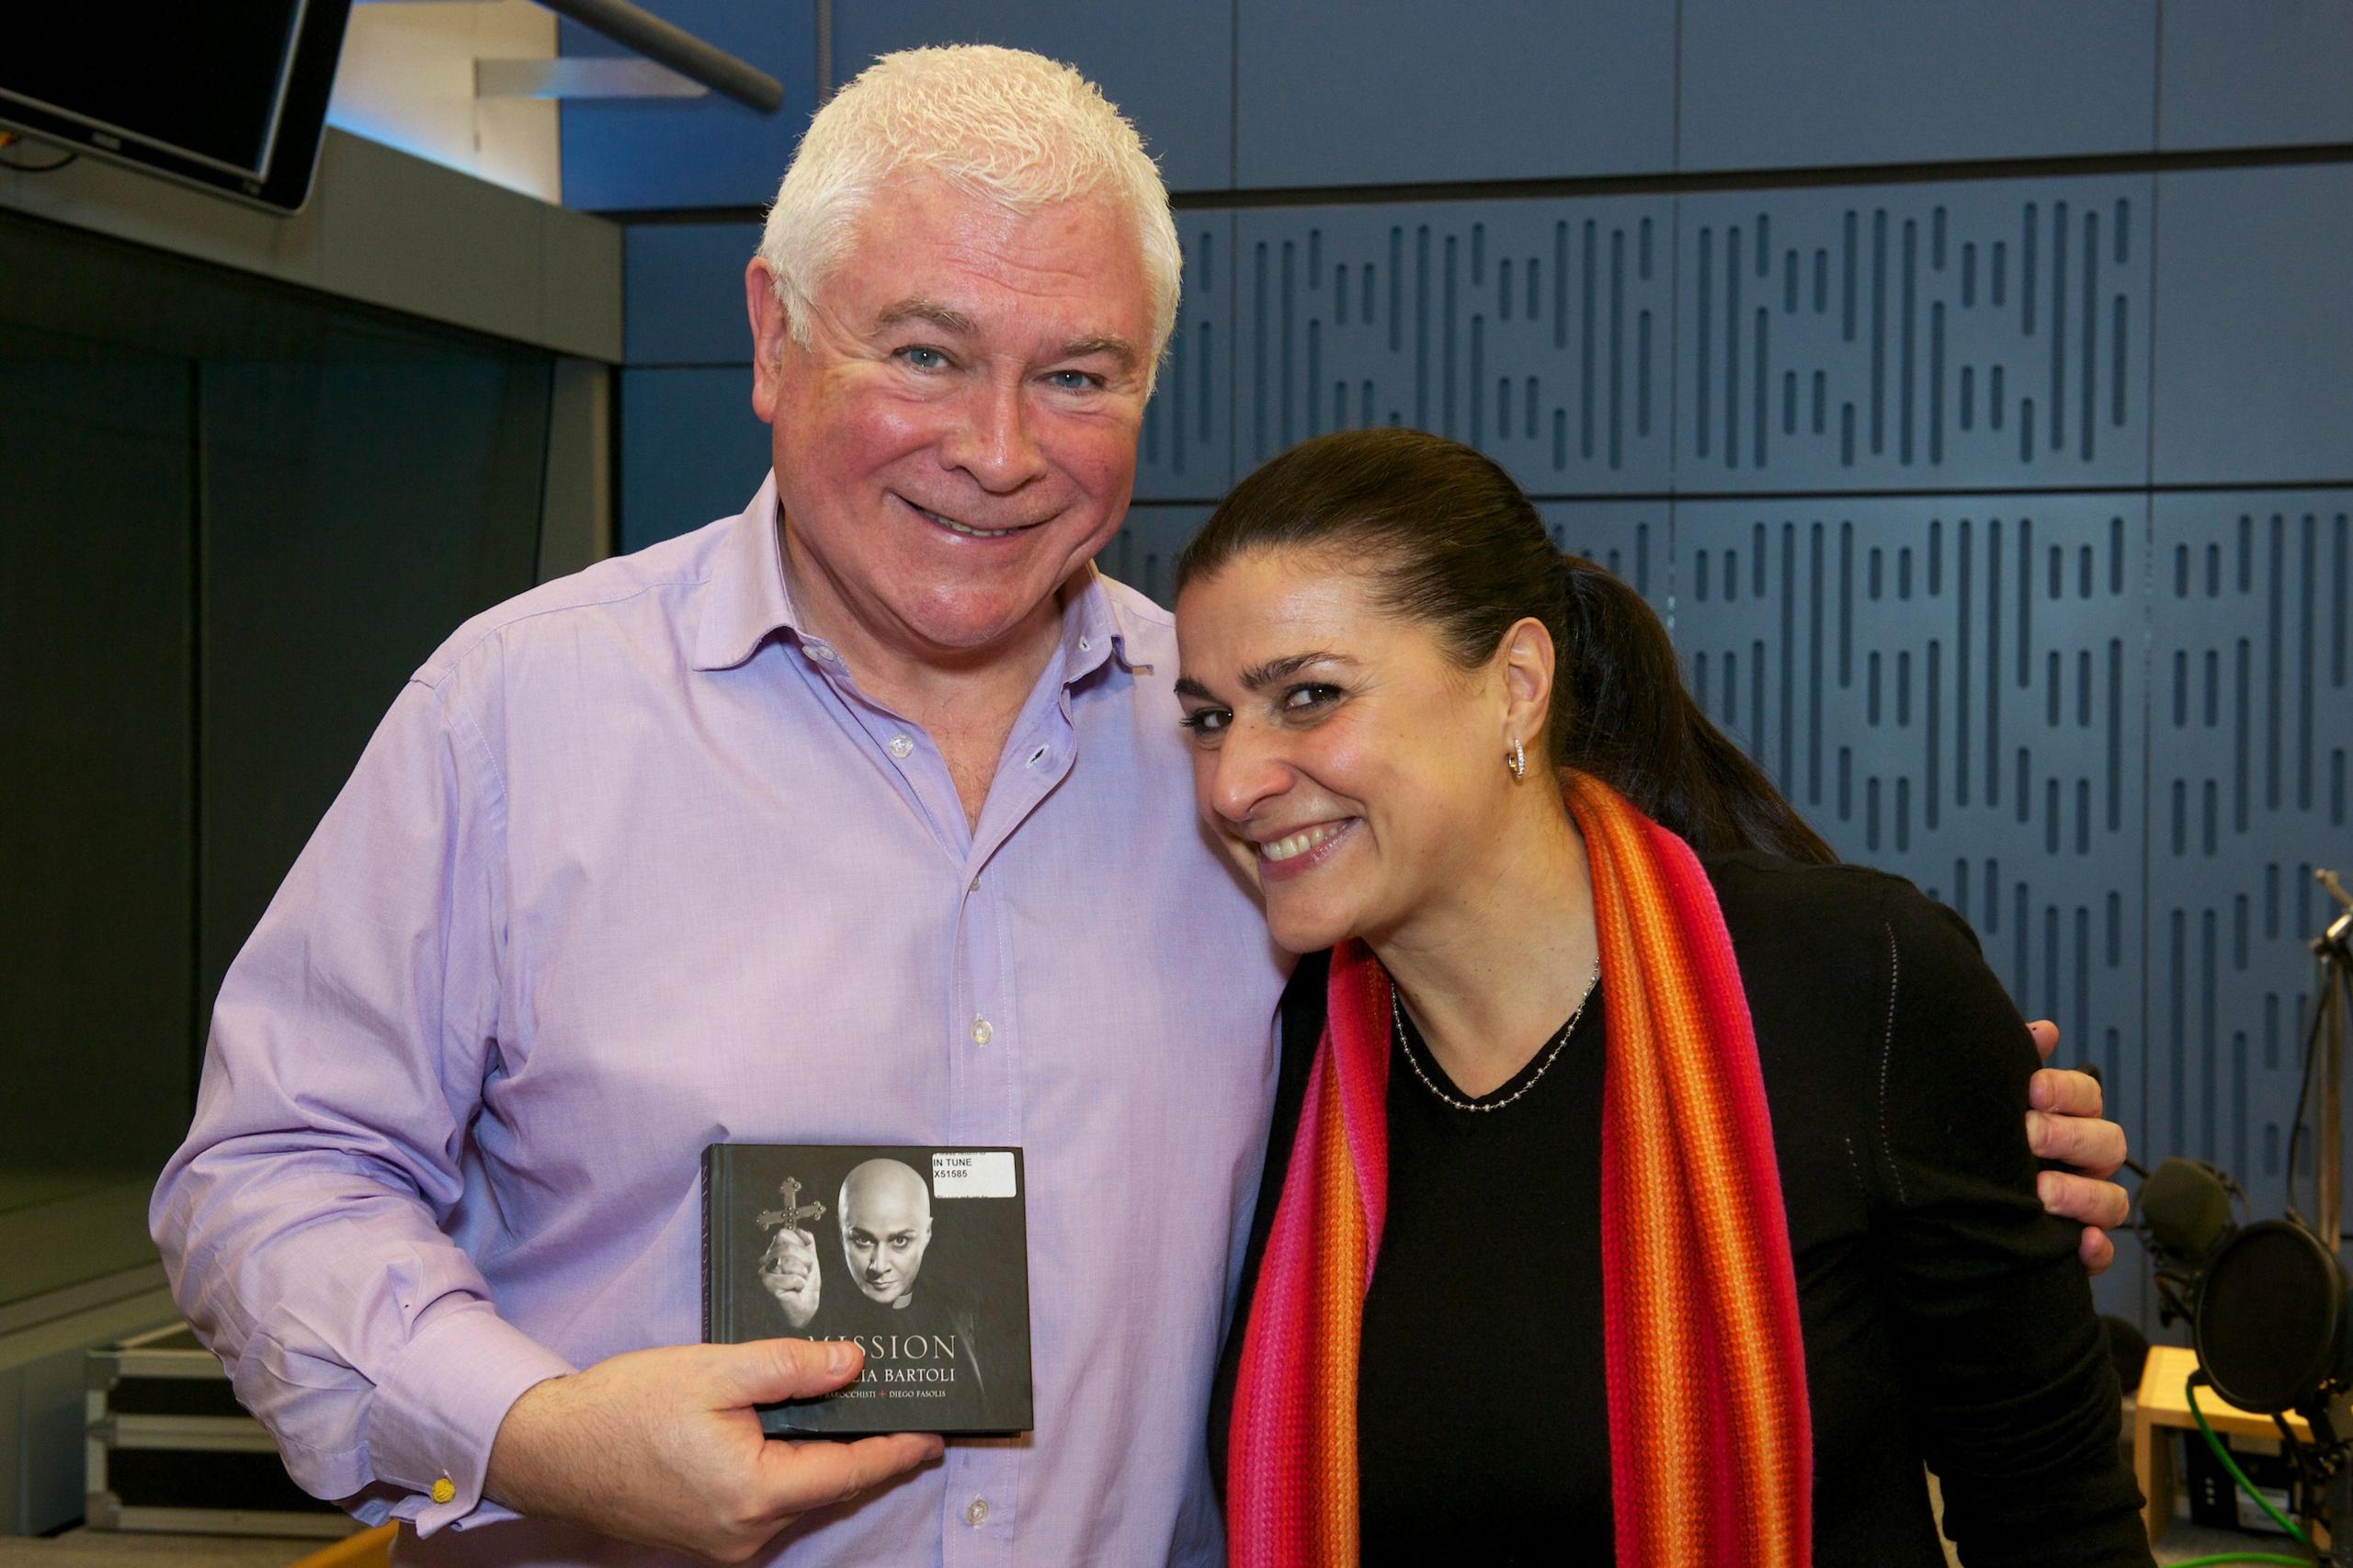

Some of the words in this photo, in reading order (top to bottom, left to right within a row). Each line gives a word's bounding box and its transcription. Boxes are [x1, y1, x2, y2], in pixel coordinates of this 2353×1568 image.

[933, 1158, 943, 1166] IN
[946, 1158, 972, 1166] TUNE
[934, 1170, 968, 1178] X51585
[808, 1335, 957, 1359] SSION
[884, 1368, 956, 1382] BARTOLI
[889, 1389, 915, 1398] DIEGO
[916, 1389, 947, 1398] FASOLIS
